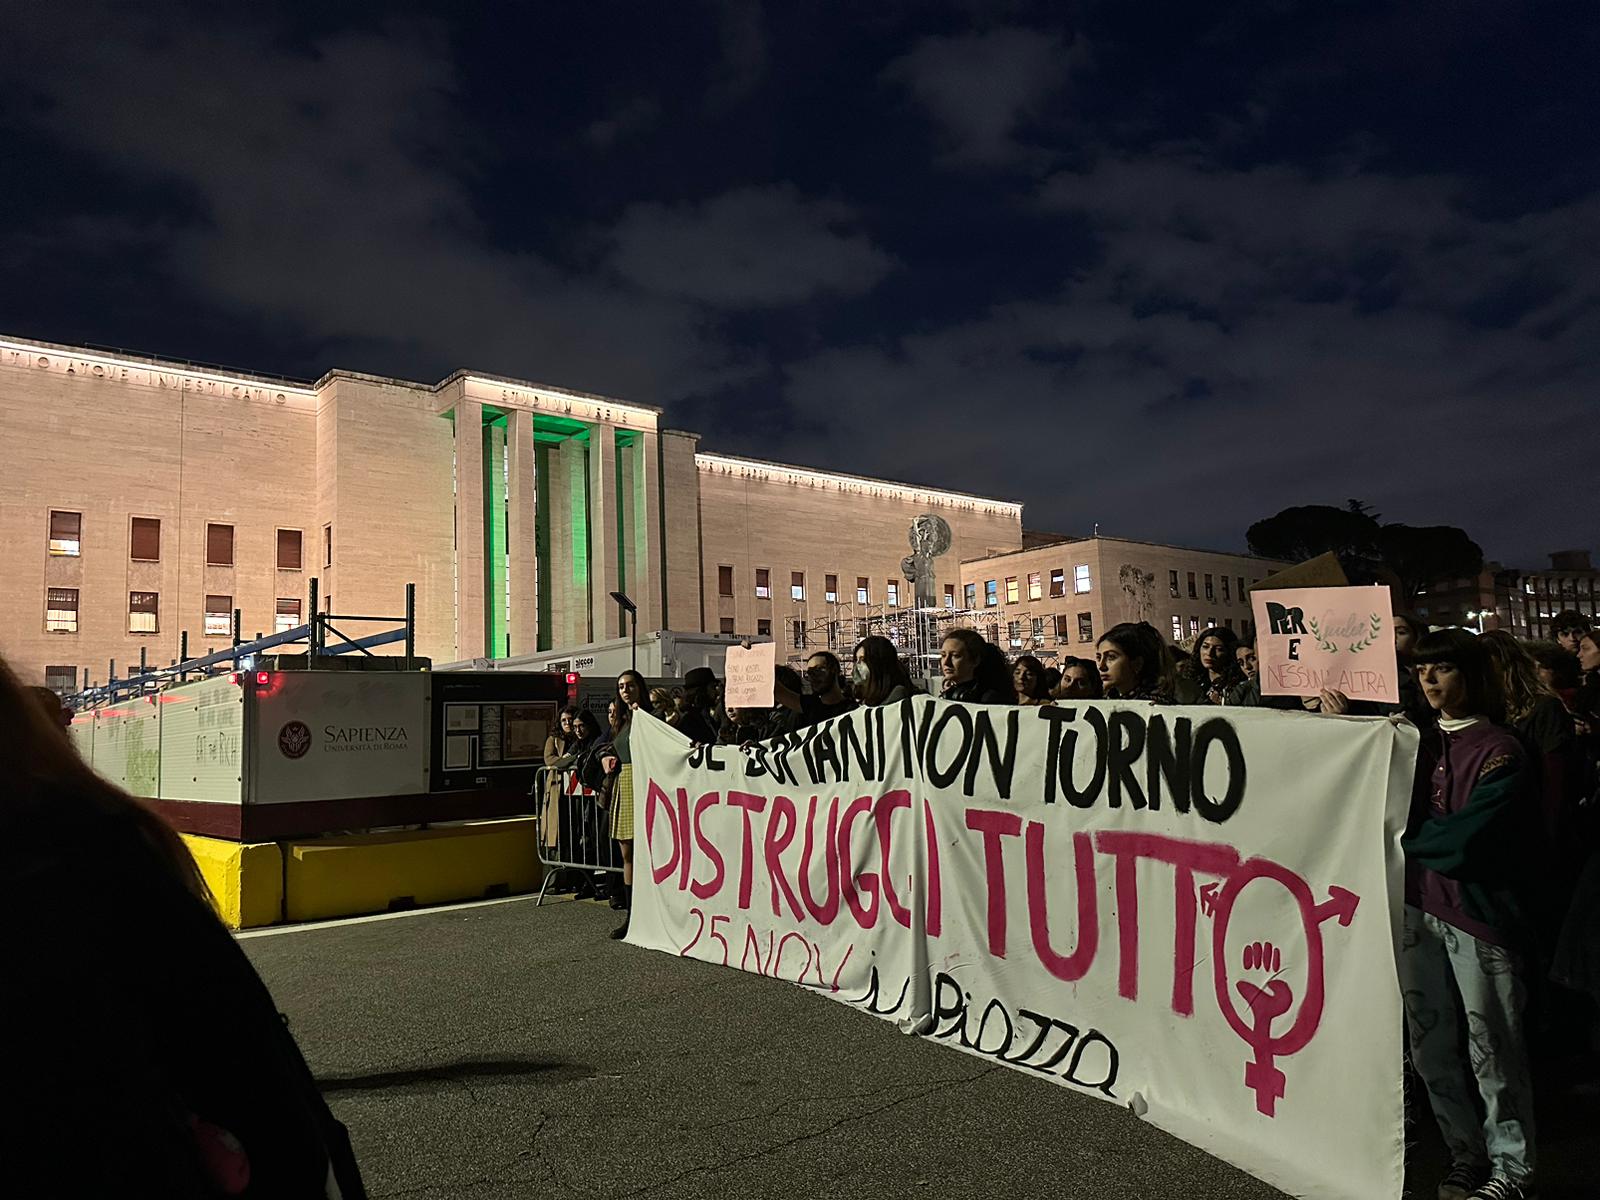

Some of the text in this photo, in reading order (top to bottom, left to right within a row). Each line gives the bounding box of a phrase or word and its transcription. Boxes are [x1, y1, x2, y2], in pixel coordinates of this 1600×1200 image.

[1337, 669, 1388, 695] ALTRA
[900, 700, 1020, 800] NON
[1038, 704, 1247, 824] TORNO
[680, 907, 730, 967] 25
